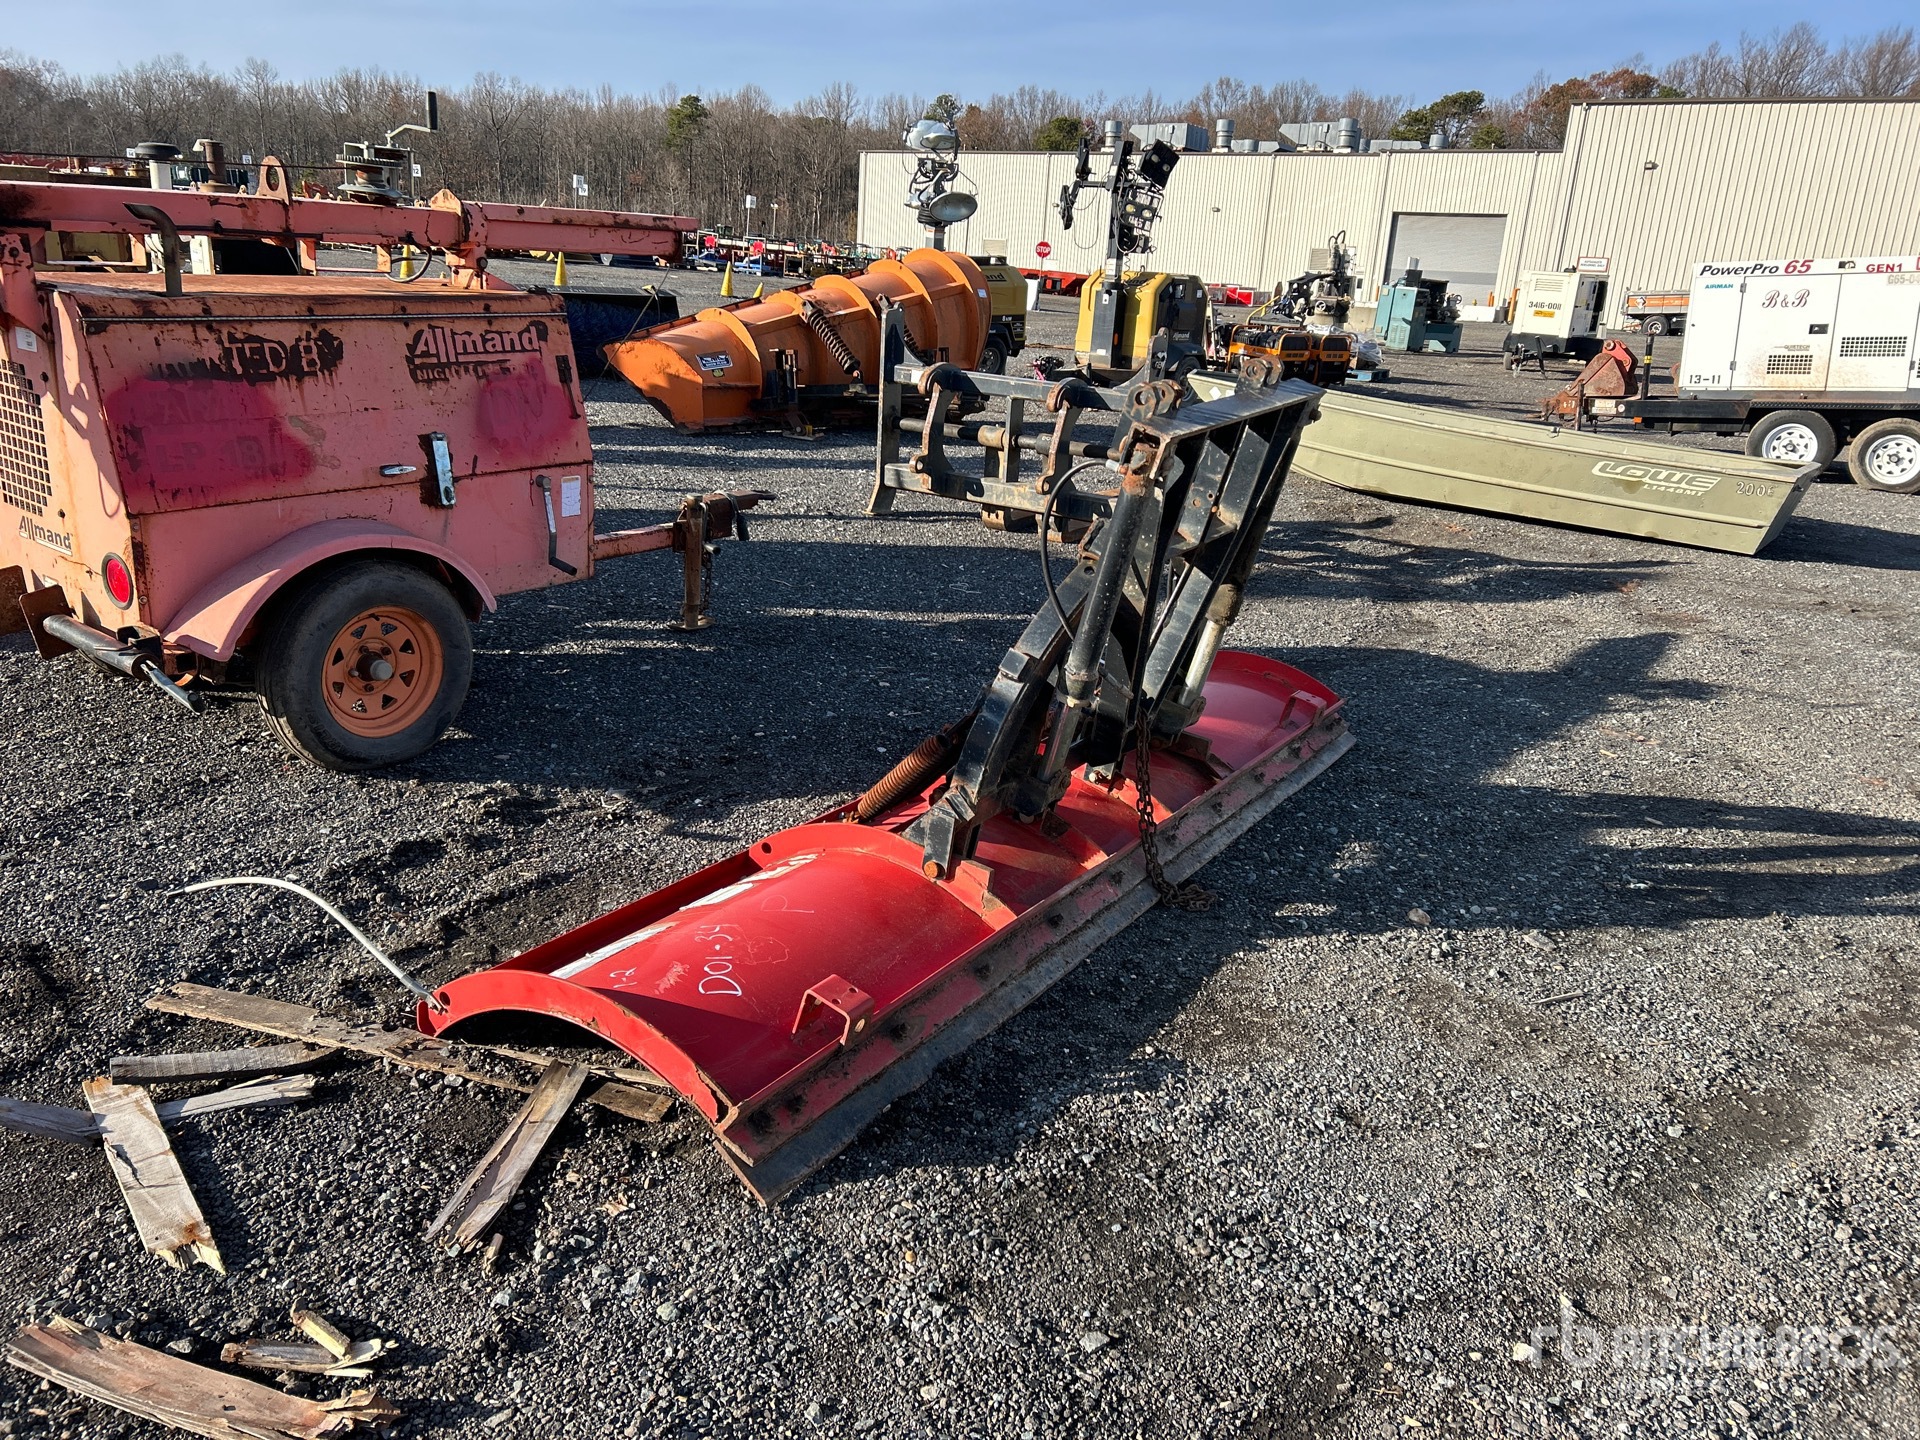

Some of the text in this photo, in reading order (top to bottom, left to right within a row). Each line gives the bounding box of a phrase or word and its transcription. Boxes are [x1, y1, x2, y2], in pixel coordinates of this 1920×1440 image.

[1699, 259, 1814, 276] PowerPro 65
[1866, 263, 1903, 273] GEN1
[1761, 288, 1811, 309] B & B
[413, 325, 541, 363] Allmand
[1689, 374, 1721, 385] 13-11
[1592, 461, 1721, 491] LOWE
[19, 515, 73, 551] Allmand
